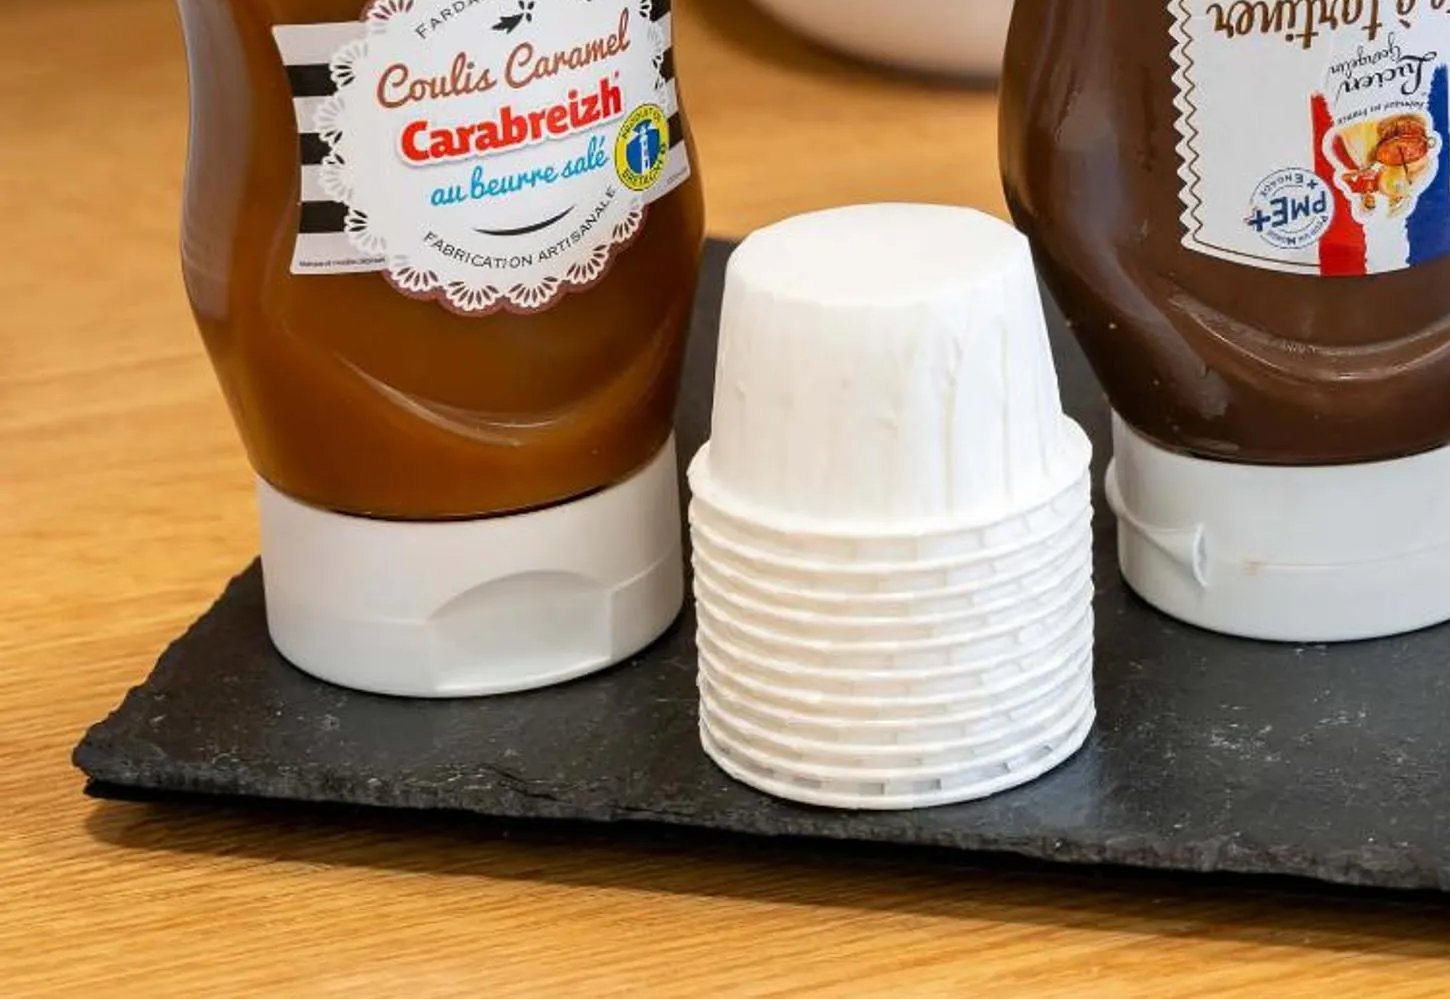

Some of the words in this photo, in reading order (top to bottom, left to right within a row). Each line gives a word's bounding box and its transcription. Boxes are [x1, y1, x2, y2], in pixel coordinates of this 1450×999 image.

[376, 51, 498, 110] Coulis
[504, 7, 631, 89] Caramel
[1329, 31, 1401, 79] Georgelin
[1335, 51, 1437, 101] Lucien
[400, 79, 623, 161] Carabreizh
[430, 183, 468, 207] au
[469, 166, 560, 201] beurre
[560, 135, 610, 179] salé
[423, 231, 533, 270] FABRICATION
[538, 186, 617, 262] ARTISANALE
